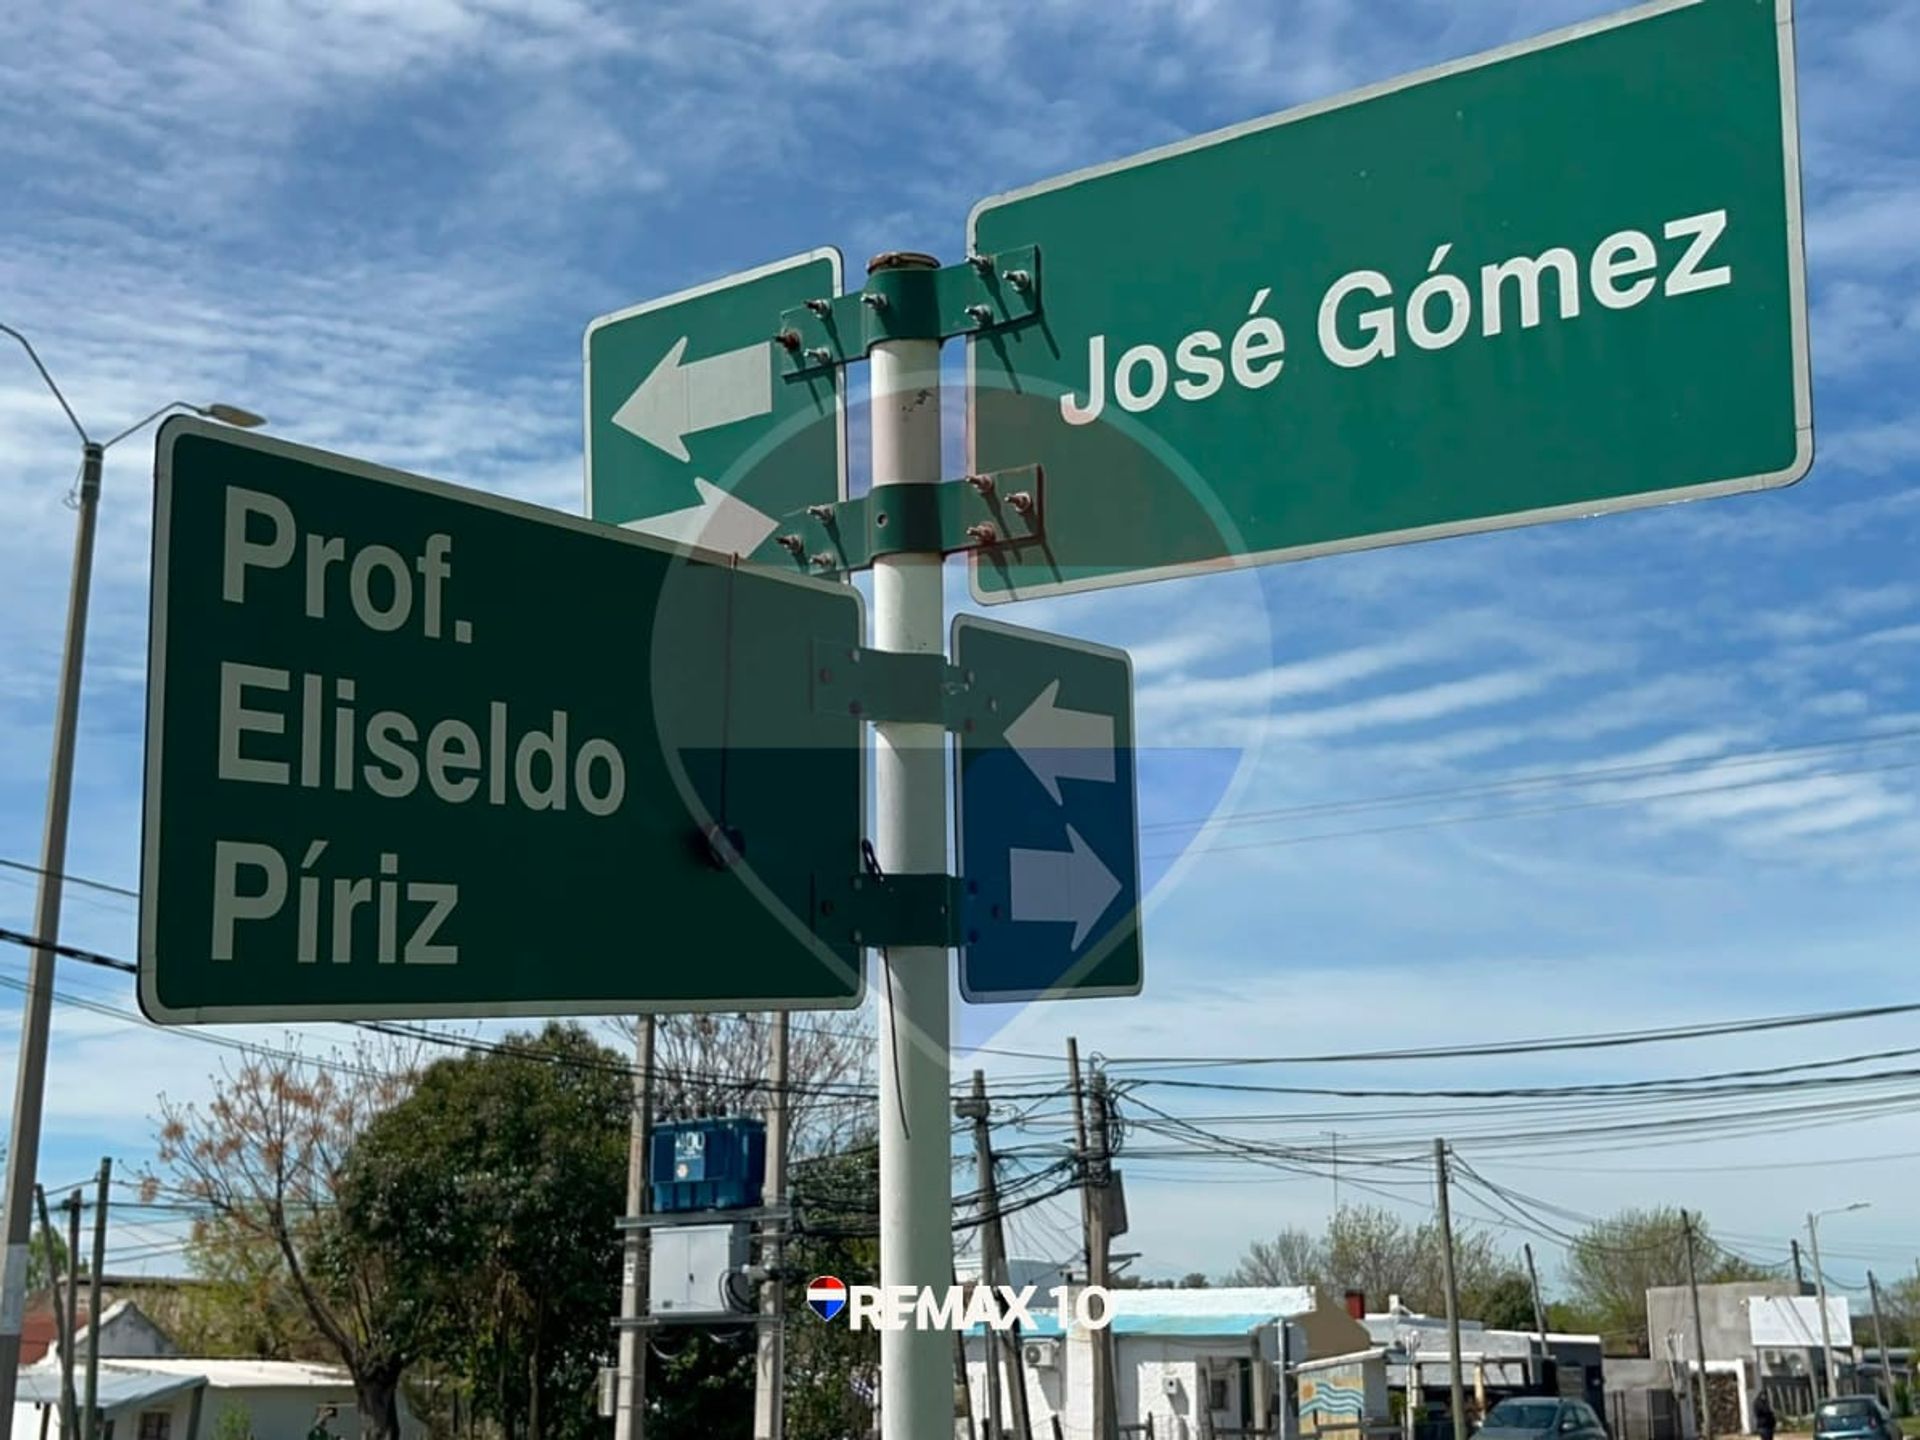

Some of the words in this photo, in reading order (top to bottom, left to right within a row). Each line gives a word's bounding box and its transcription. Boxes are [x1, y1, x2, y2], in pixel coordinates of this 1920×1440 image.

[1060, 288, 1285, 426] José
[1318, 209, 1732, 368] Gómez
[223, 484, 473, 643] Prof.
[218, 661, 626, 816] Eliseldo
[210, 839, 459, 965] Píriz
